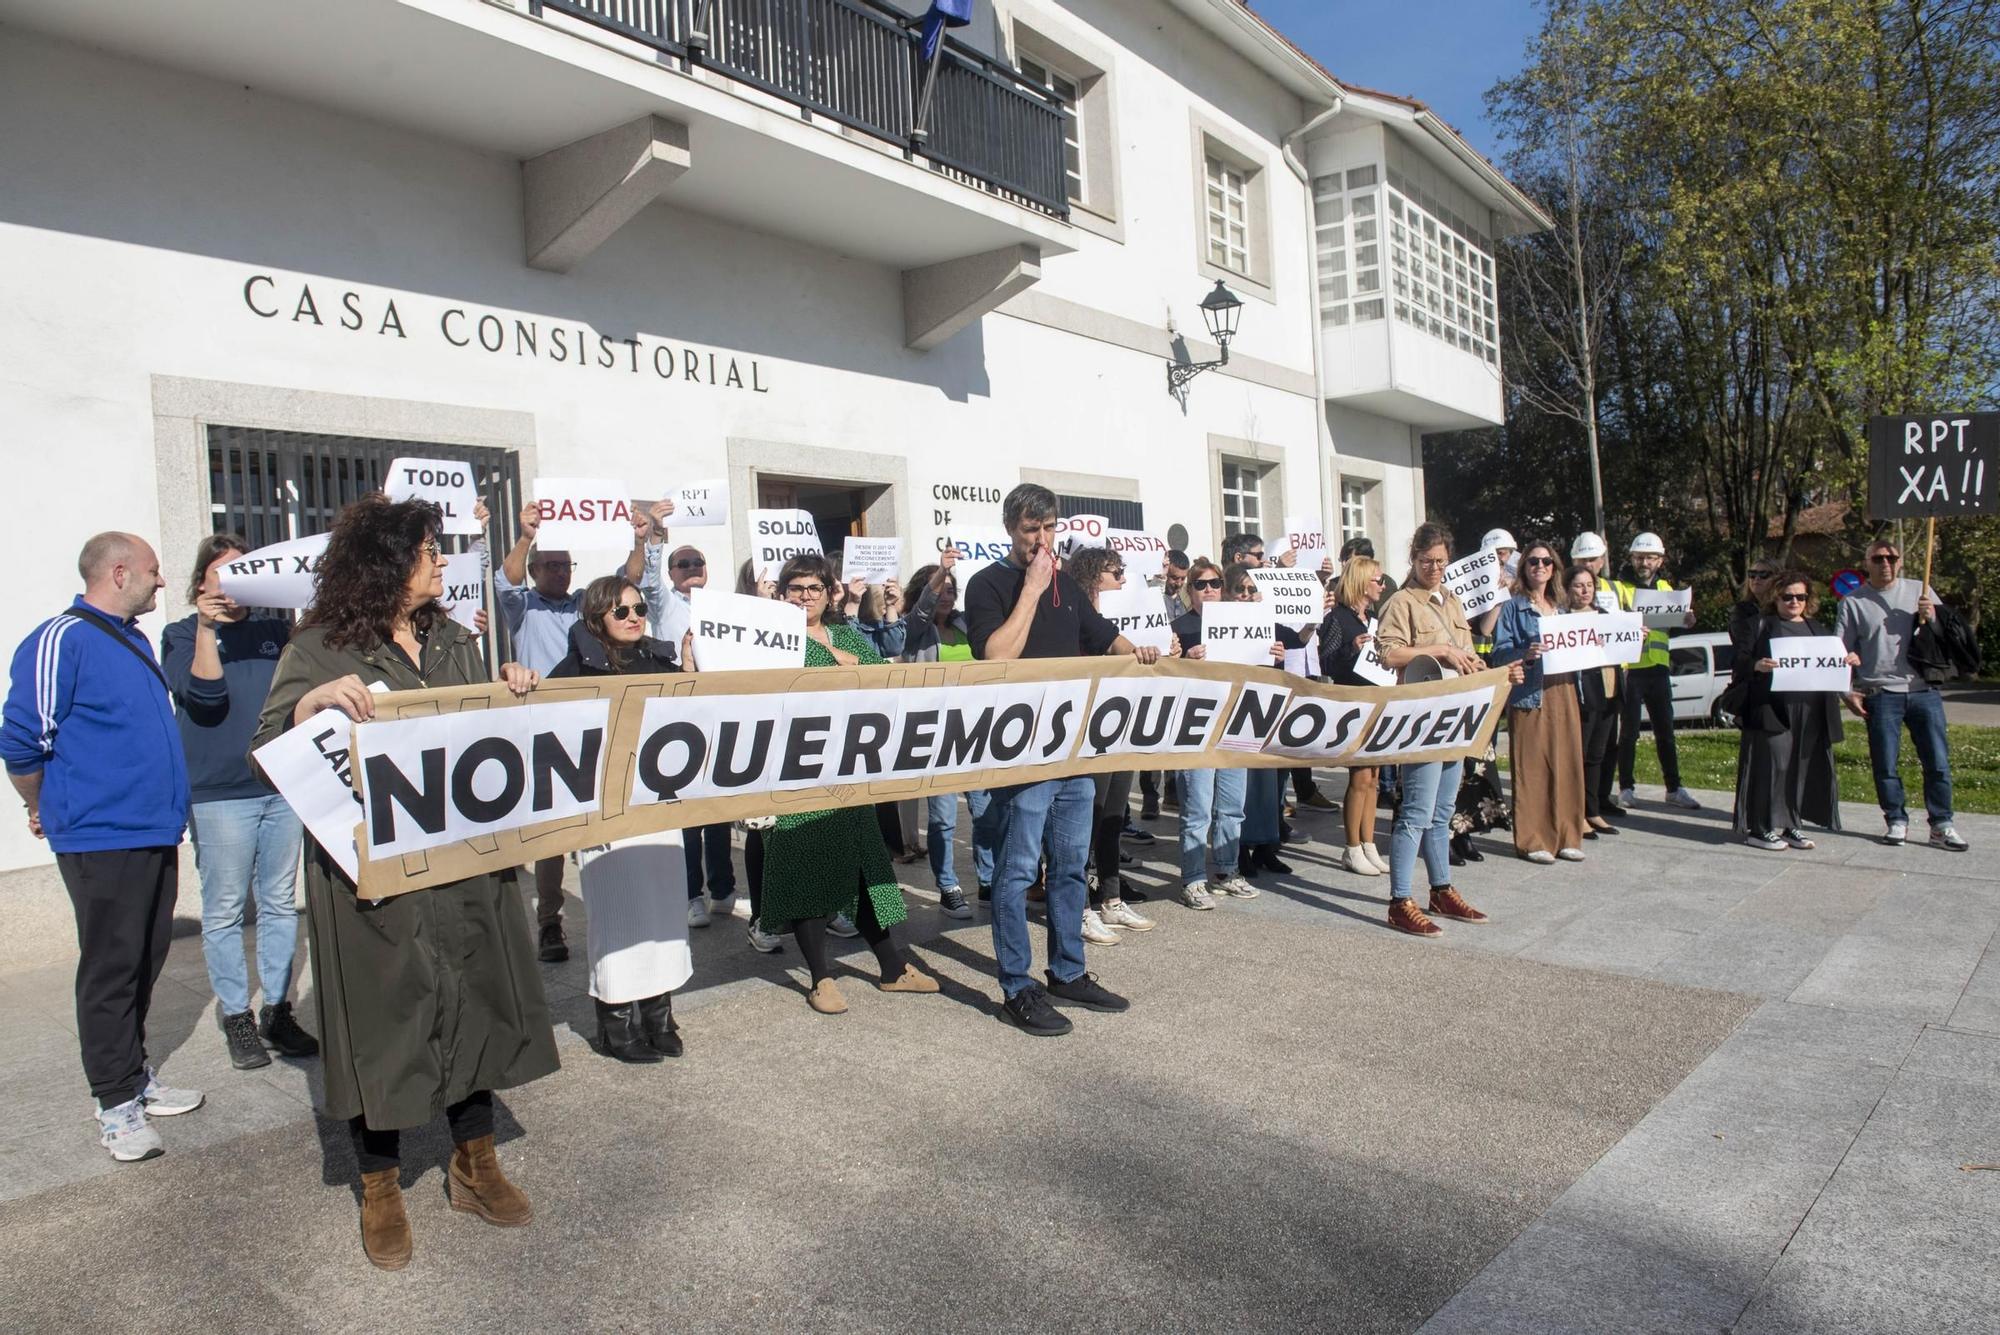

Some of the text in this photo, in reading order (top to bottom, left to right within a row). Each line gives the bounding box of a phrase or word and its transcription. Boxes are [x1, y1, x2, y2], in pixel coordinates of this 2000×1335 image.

[244, 275, 768, 393] CASA CONSISTORIAL
[403, 468, 465, 488] TODO
[682, 489, 710, 500] RPT
[933, 484, 1000, 503] CONCELLO
[539, 499, 631, 521] BASTA
[687, 506, 706, 517] XA
[1055, 519, 1102, 537] ODO
[1110, 536, 1167, 552] BASTA
[229, 557, 283, 575] RPT
[1440, 553, 1496, 584] ULLERES
[1254, 572, 1317, 582] MULLERES
[1450, 574, 1490, 596] OLDO
[446, 583, 479, 601] XA!!
[1273, 587, 1312, 597] SOLDO
[1462, 591, 1495, 611] IGNO
[1275, 604, 1312, 615] DIGNO
[700, 620, 800, 651] RPT XA!!
[1208, 626, 1272, 639] RPT XA!!
[1543, 628, 1598, 650] BASTA
[1615, 631, 1640, 642] XA!!
[1779, 657, 1811, 668] RPT
[365, 689, 1491, 846] NON QUEREMOS QUE NOS USEN
